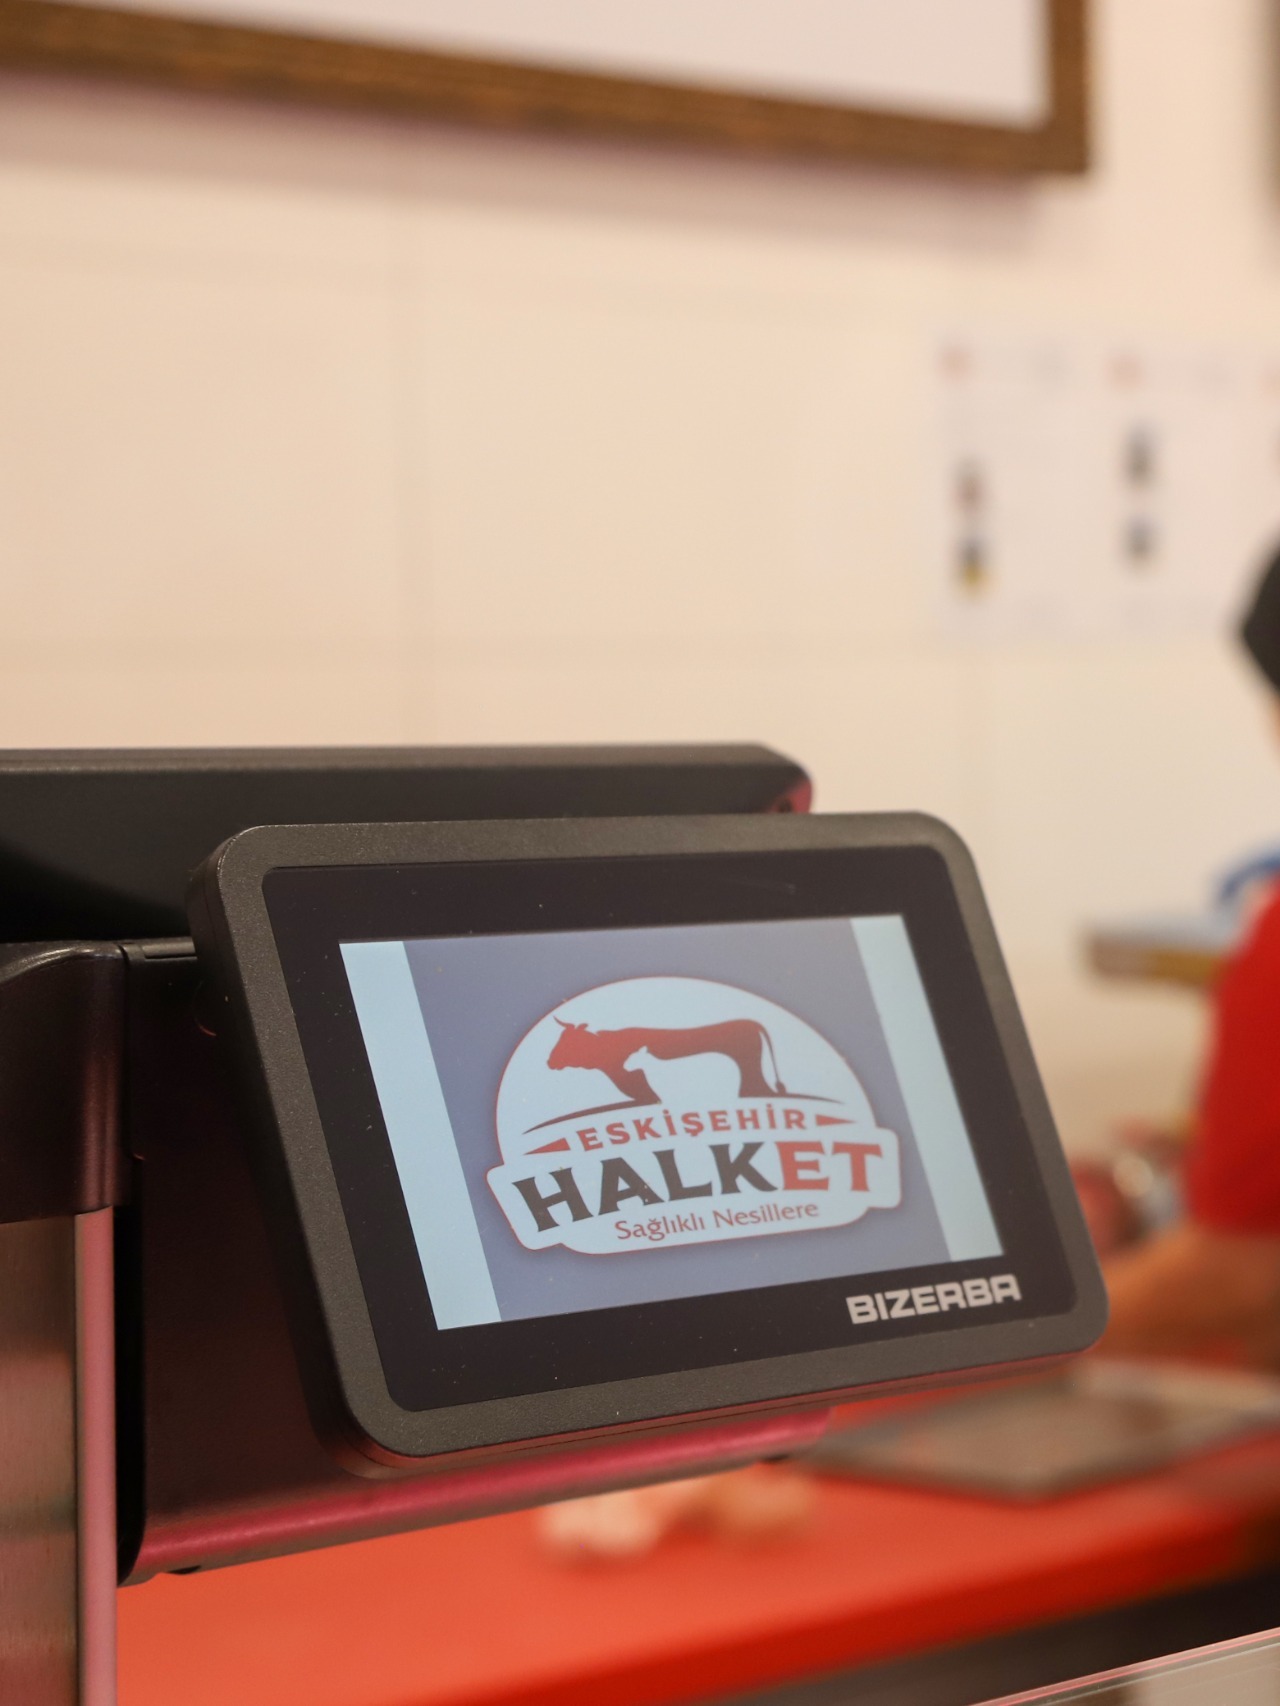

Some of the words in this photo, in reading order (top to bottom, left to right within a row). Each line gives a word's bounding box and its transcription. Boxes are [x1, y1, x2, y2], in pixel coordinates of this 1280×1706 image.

[575, 1103, 806, 1152] ESKİŞEHİR
[511, 1141, 883, 1232] HALKET
[614, 1213, 706, 1242] Sağlıklı
[713, 1202, 819, 1228] Nesillere
[846, 1273, 1022, 1325] BIZERBA
